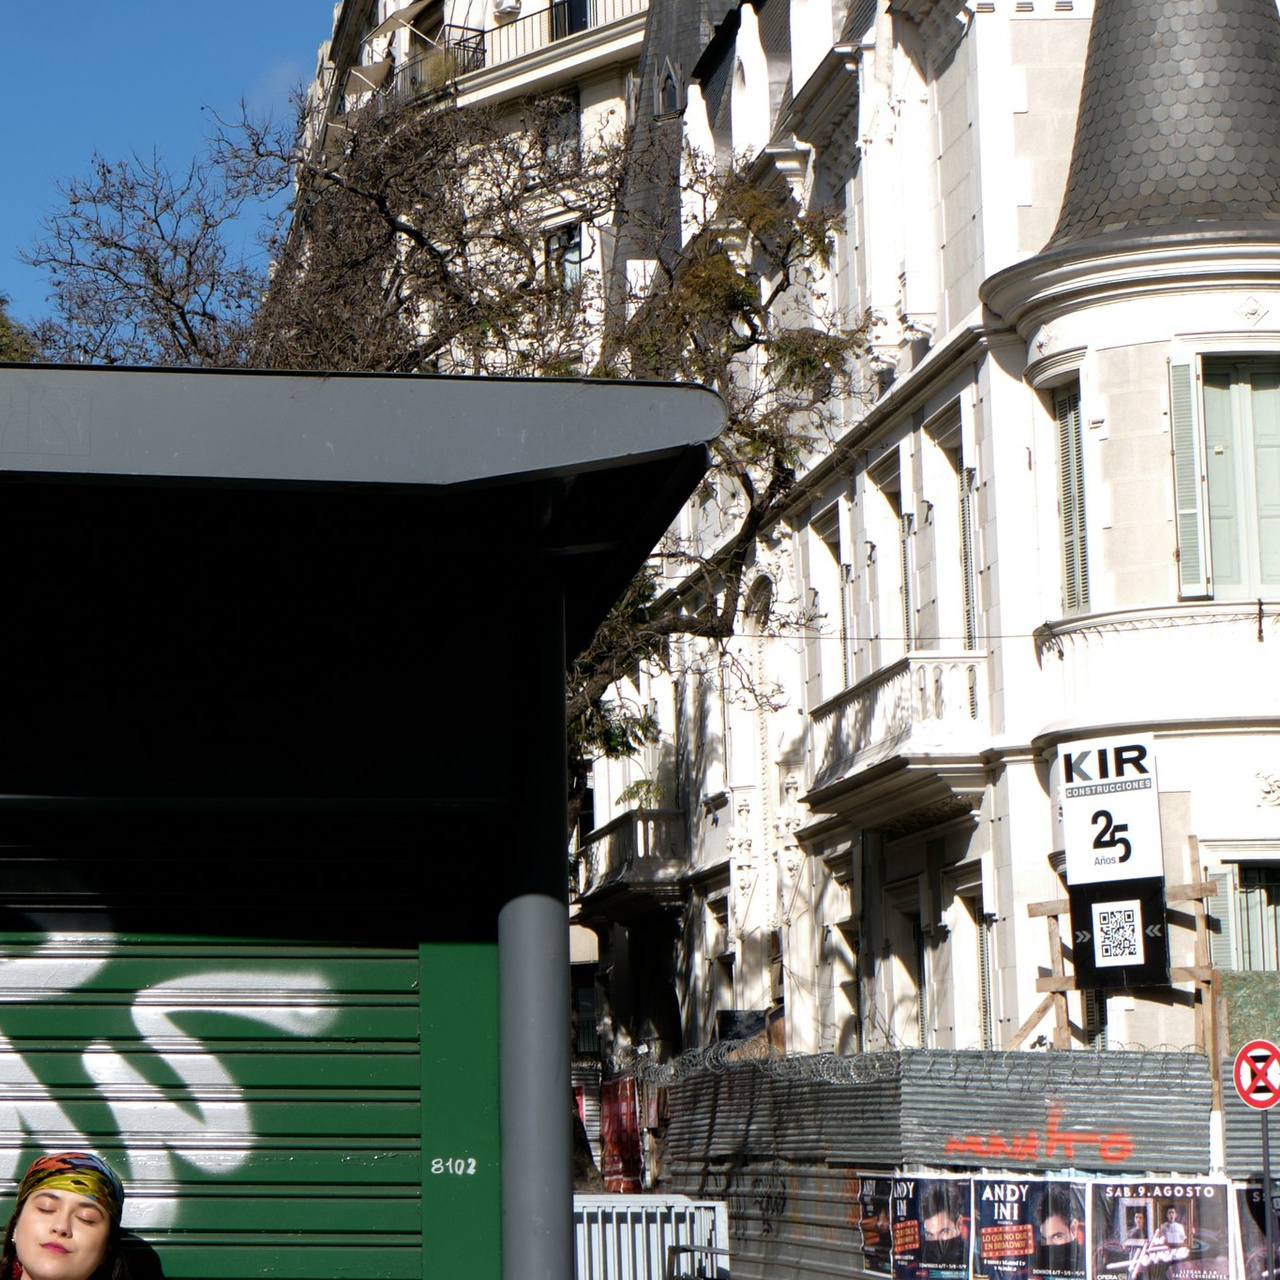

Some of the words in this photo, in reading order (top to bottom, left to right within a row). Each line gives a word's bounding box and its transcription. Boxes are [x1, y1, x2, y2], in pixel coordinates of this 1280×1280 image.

[1063, 744, 1150, 783] KIR
[1066, 779, 1151, 797] CONSTRUCCIONES
[1091, 809, 1132, 863] 25
[1094, 856, 1116, 866] Años
[431, 1157, 477, 1175] 8102
[982, 1184, 1029, 1202] ANDY
[994, 1202, 1019, 1220] INI
[1003, 1232, 1014, 1241] NO
[984, 1242, 993, 1250] EN
